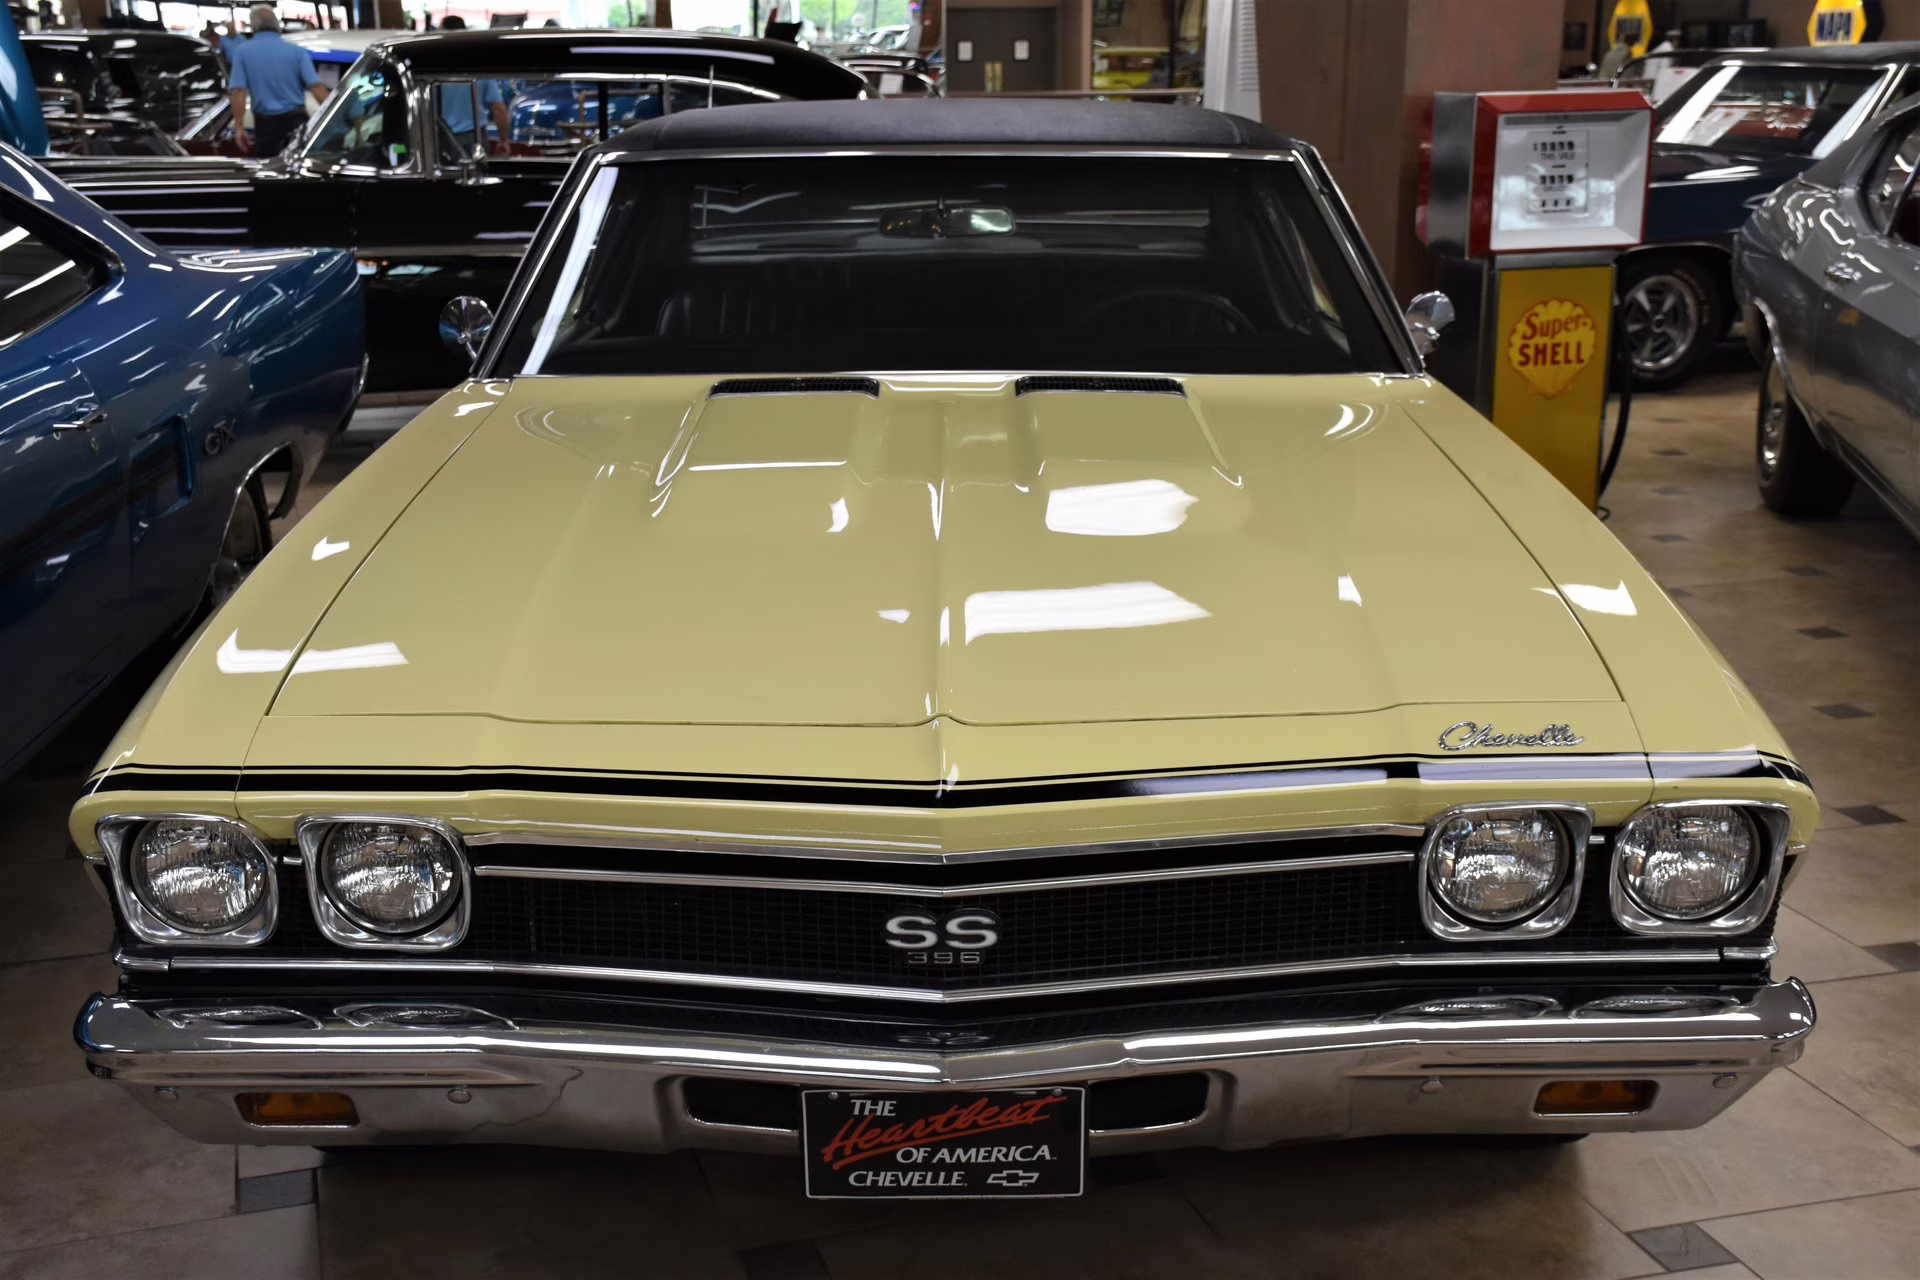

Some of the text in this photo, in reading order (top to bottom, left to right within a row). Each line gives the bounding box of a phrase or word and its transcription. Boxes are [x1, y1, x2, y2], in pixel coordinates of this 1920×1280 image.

[1518, 341, 1585, 367] SHELL
[1438, 720, 1585, 751] Chevelle
[885, 915, 998, 949] SS
[907, 951, 981, 964] 396
[851, 1099, 897, 1116] THE
[821, 1095, 1067, 1163] Heartbeat
[896, 1144, 1051, 1164] OF AMERICA
[848, 1170, 965, 1186] CHEVELLE
